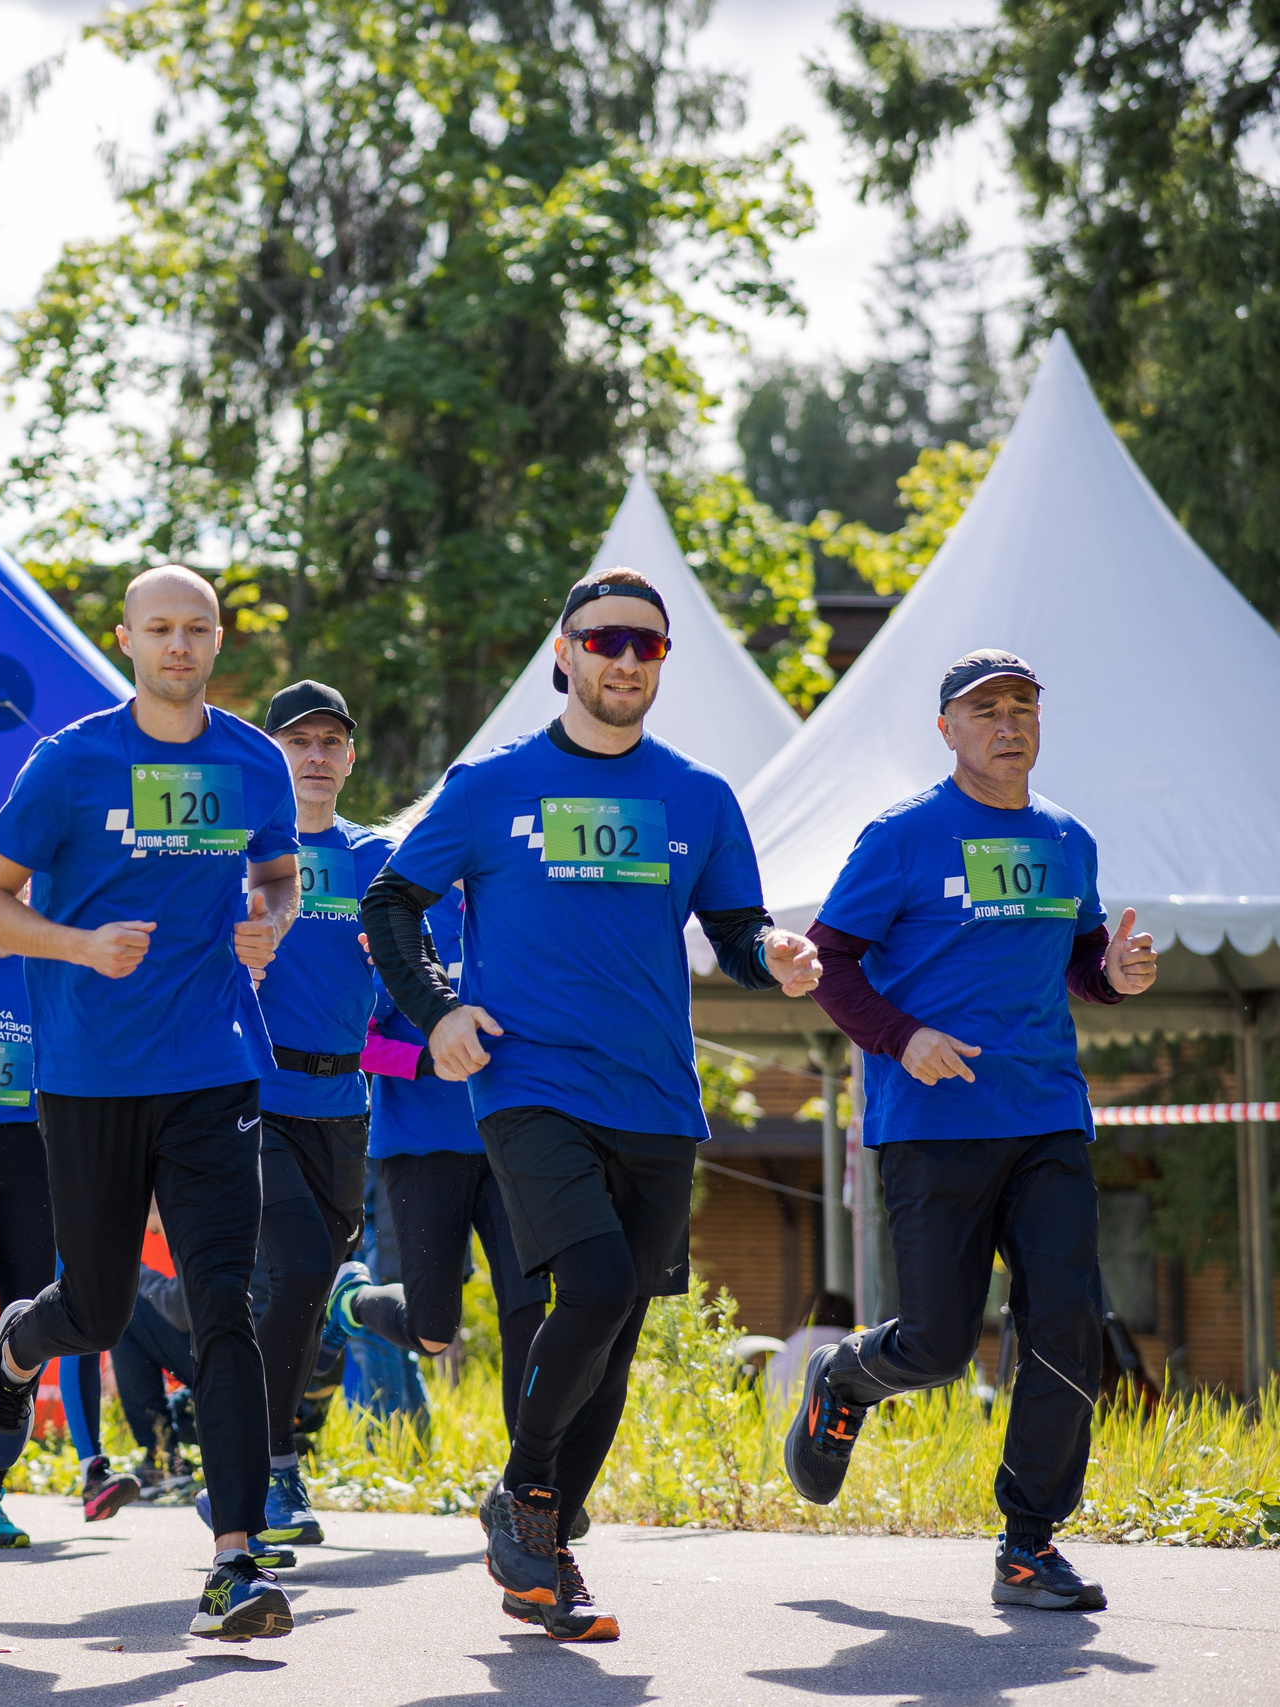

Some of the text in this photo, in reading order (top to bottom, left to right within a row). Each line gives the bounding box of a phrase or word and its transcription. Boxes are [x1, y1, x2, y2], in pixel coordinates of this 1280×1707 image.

[159, 792, 220, 825] 120
[137, 835, 189, 848] АТОМ-СЛЕТ
[572, 824, 640, 857] 102
[299, 866, 329, 893] 01
[548, 866, 660, 878] АТОМ-СЛЕТ Росэнергоатом-1
[991, 863, 1047, 895] 107
[974, 904, 1025, 918] АТОМ-СЛЕТ
